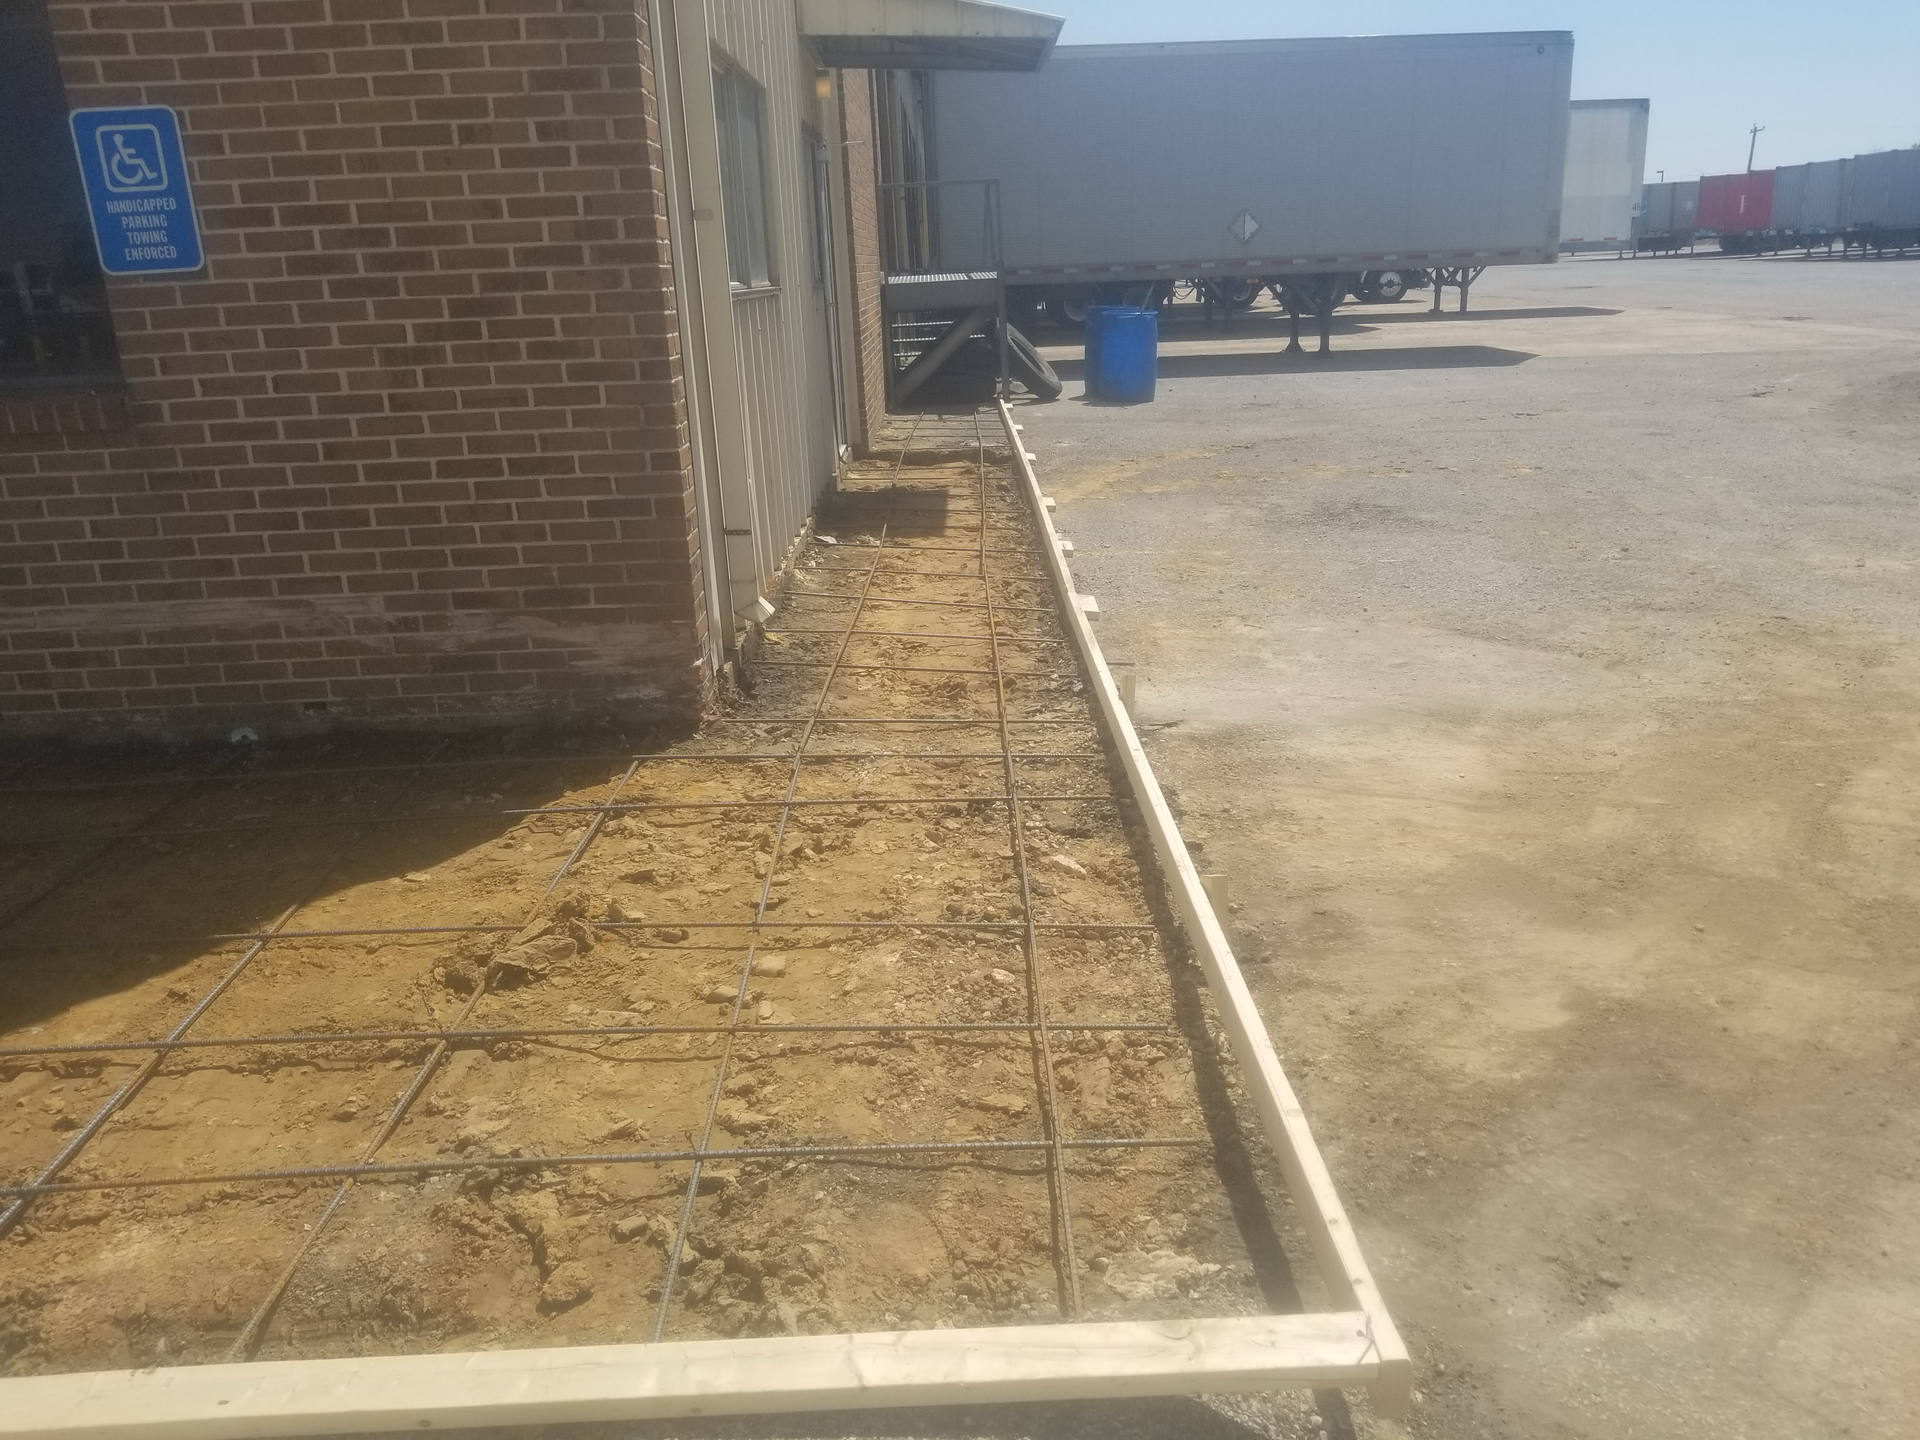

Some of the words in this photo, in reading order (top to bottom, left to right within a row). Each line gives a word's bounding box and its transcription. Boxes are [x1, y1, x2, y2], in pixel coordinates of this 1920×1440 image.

[106, 197, 176, 214] HANDICAPPED
[121, 214, 168, 229] PARKING
[126, 230, 168, 244] TOWING
[124, 245, 177, 261] ENFORCED
